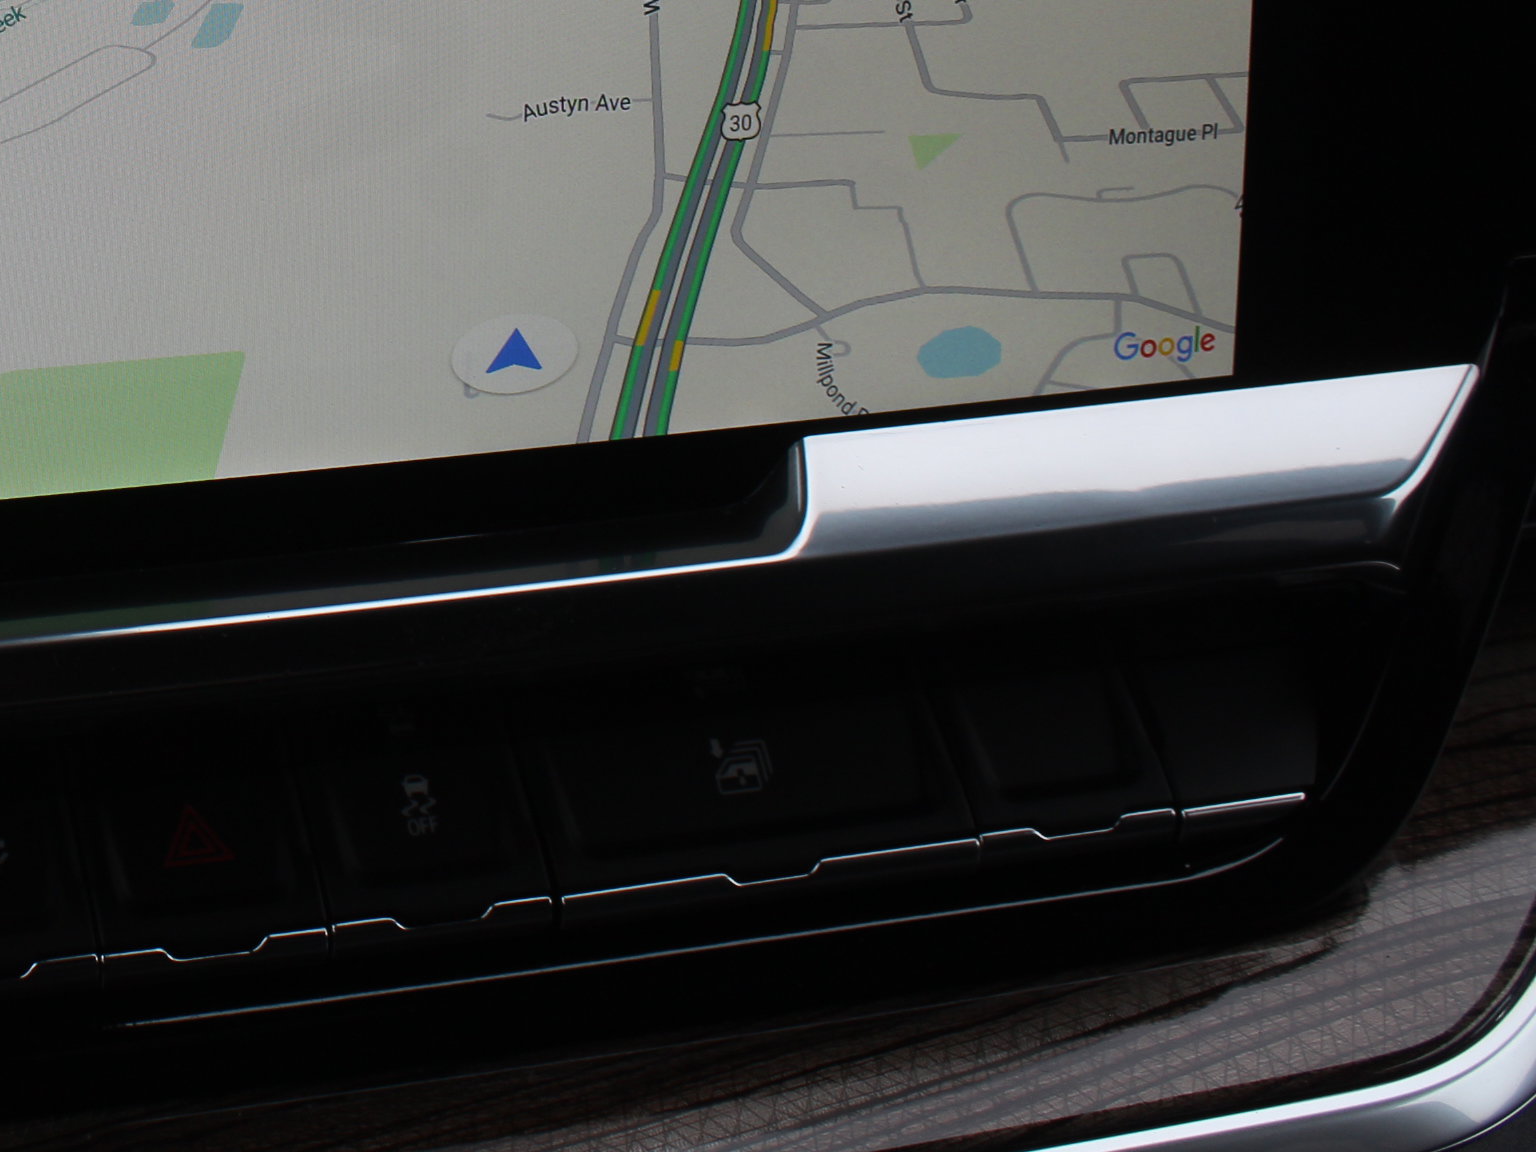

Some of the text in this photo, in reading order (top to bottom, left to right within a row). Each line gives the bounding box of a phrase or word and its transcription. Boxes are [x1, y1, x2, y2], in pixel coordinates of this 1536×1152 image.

[896, 0, 914, 24] St
[523, 93, 631, 123] Austyn Ave
[730, 114, 752, 132] 30
[1108, 123, 1218, 147] Montague Pl
[1114, 325, 1216, 363] Google
[816, 342, 858, 416] Millpond
